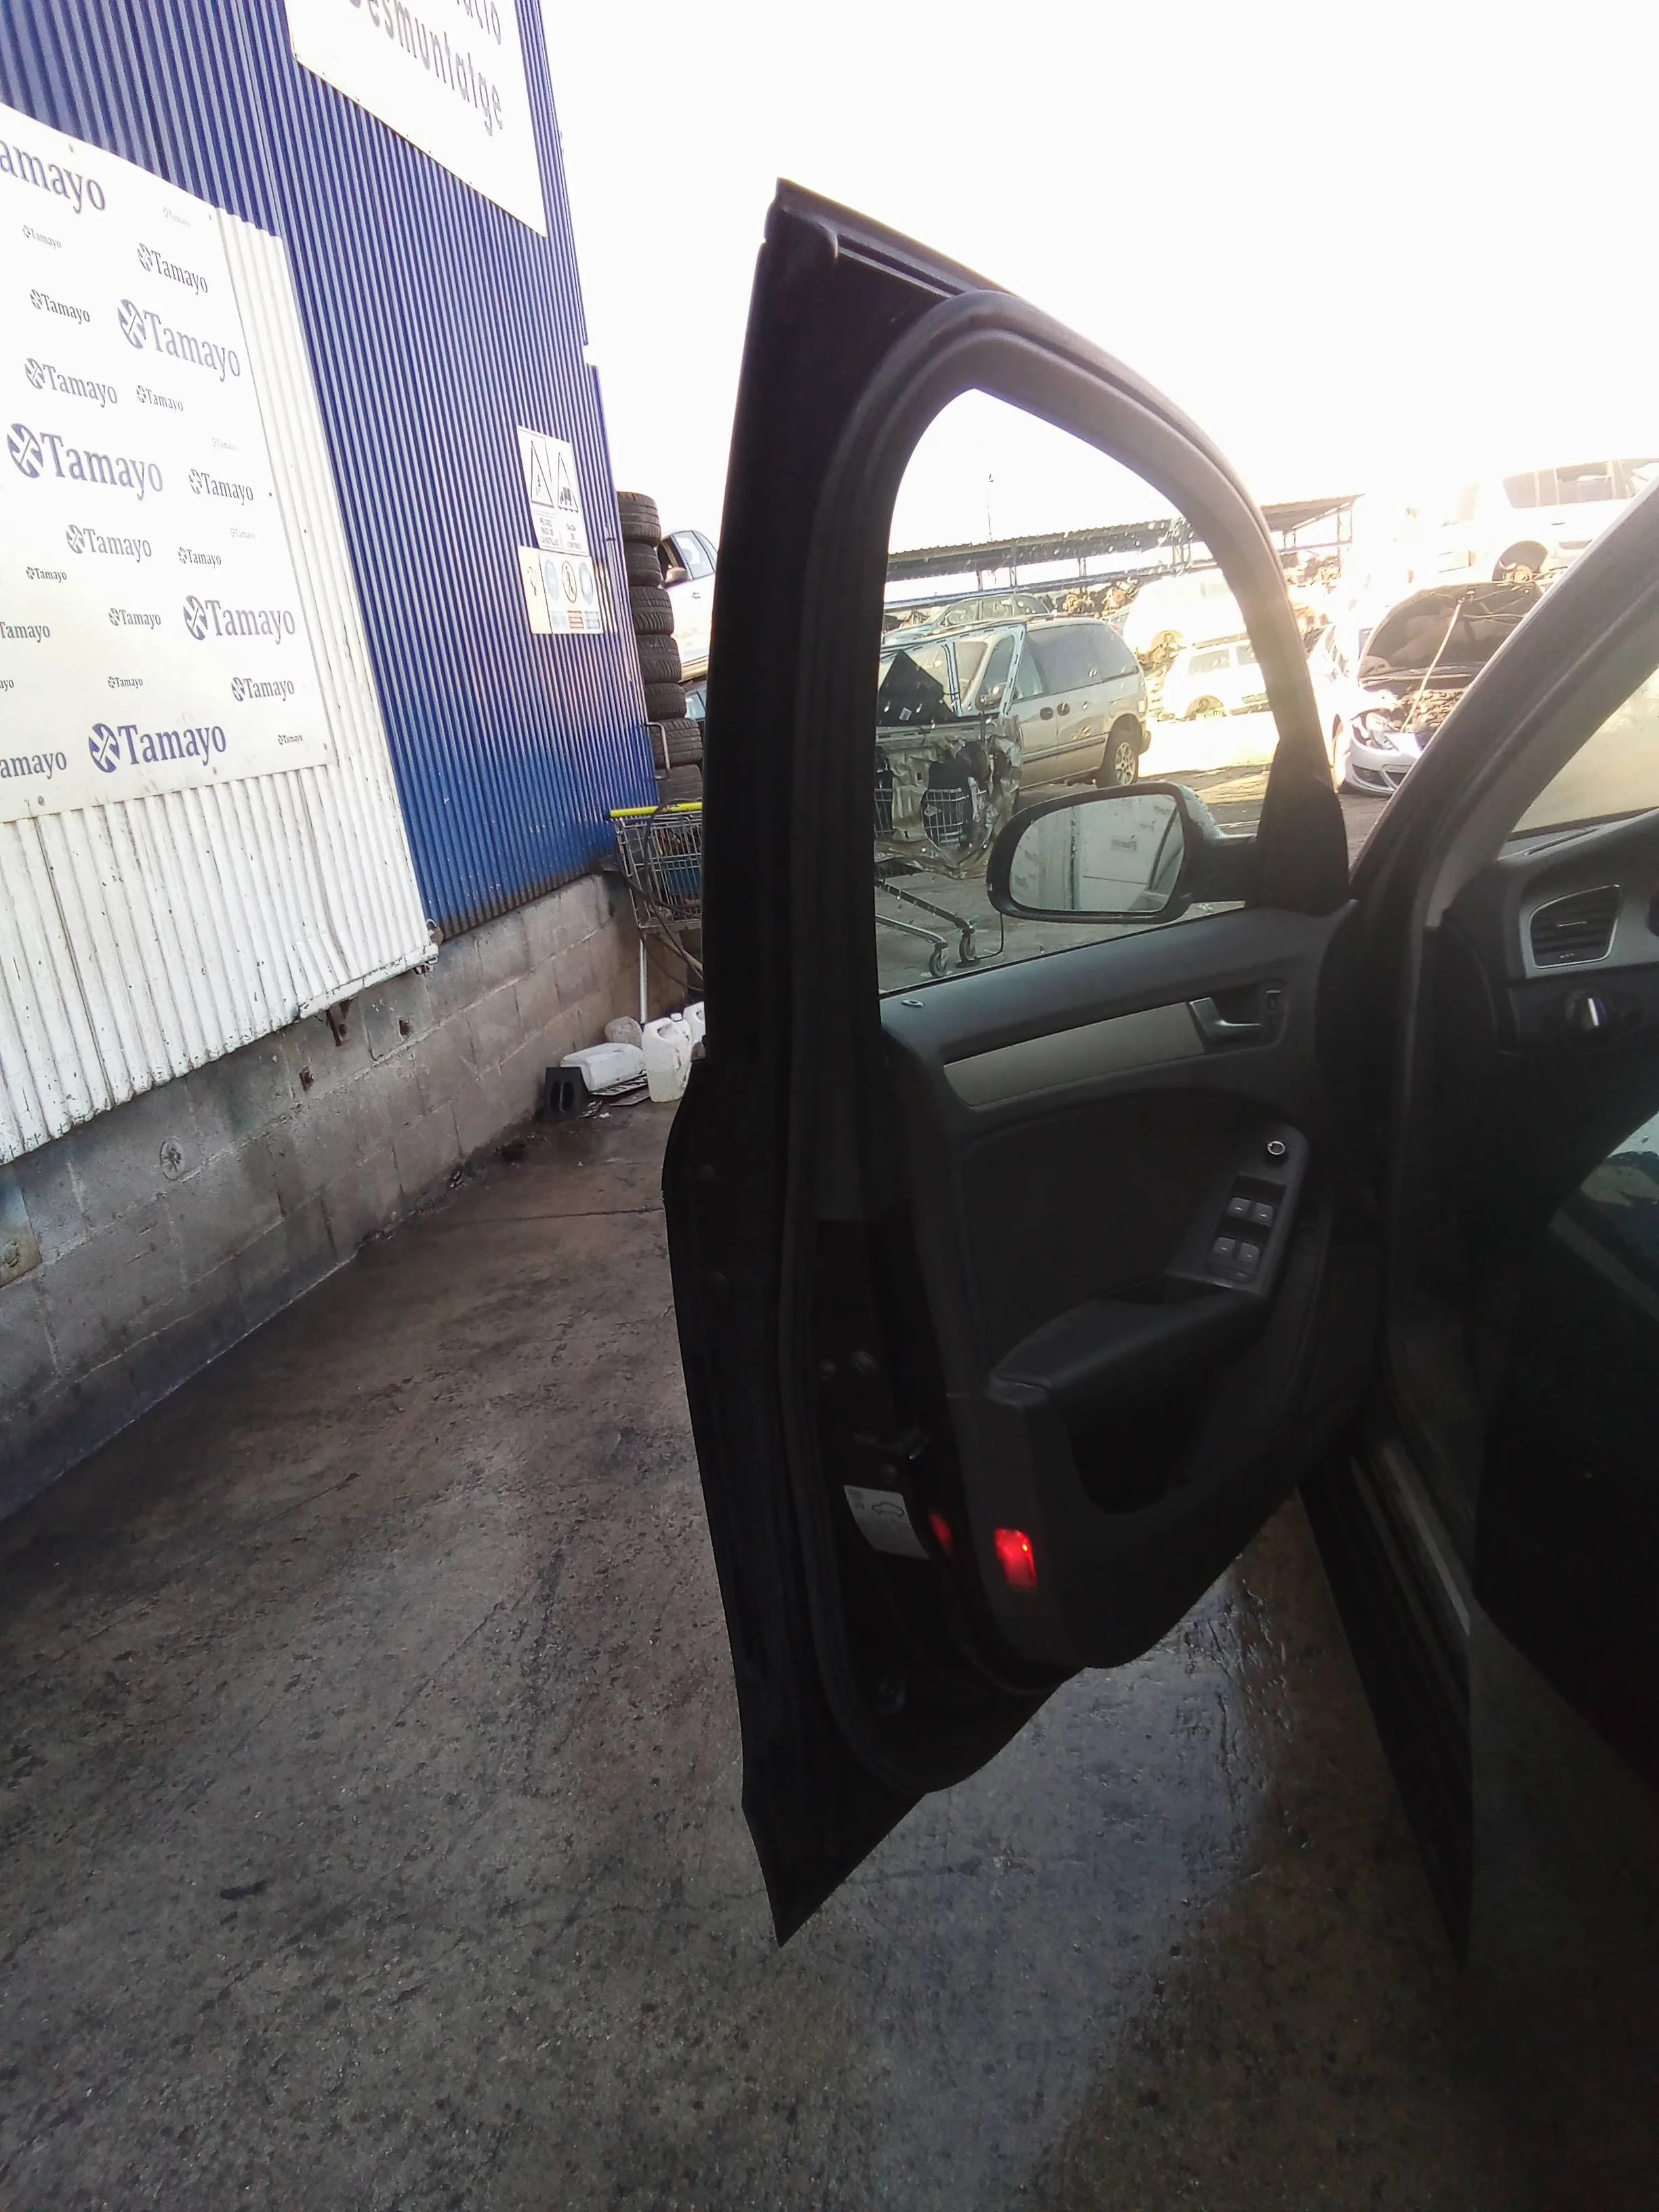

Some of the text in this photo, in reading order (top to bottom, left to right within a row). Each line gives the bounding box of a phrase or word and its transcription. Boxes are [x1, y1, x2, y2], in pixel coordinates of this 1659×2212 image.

[0, 140, 106, 214] amayo
[151, 250, 208, 295] Tamayo
[41, 293, 90, 325] Tamayo
[144, 308, 241, 382] Tamayo
[42, 363, 118, 408] Tamayo
[144, 388, 184, 412] Tamayo
[40, 432, 163, 501] Tamayo
[201, 472, 254, 506] Tamayo
[83, 528, 152, 562] Tamayo
[186, 548, 222, 569] Tamayo
[34, 567, 67, 583] Tamayo
[0, 621, 50, 643] Tamayo
[119, 609, 161, 630] Tamayo
[205, 599, 295, 645] Tamayo
[114, 678, 143, 690] Tamayo
[245, 678, 295, 701] Tamayo
[117, 724, 226, 766] Tamayo
[0, 752, 67, 780] amayo
